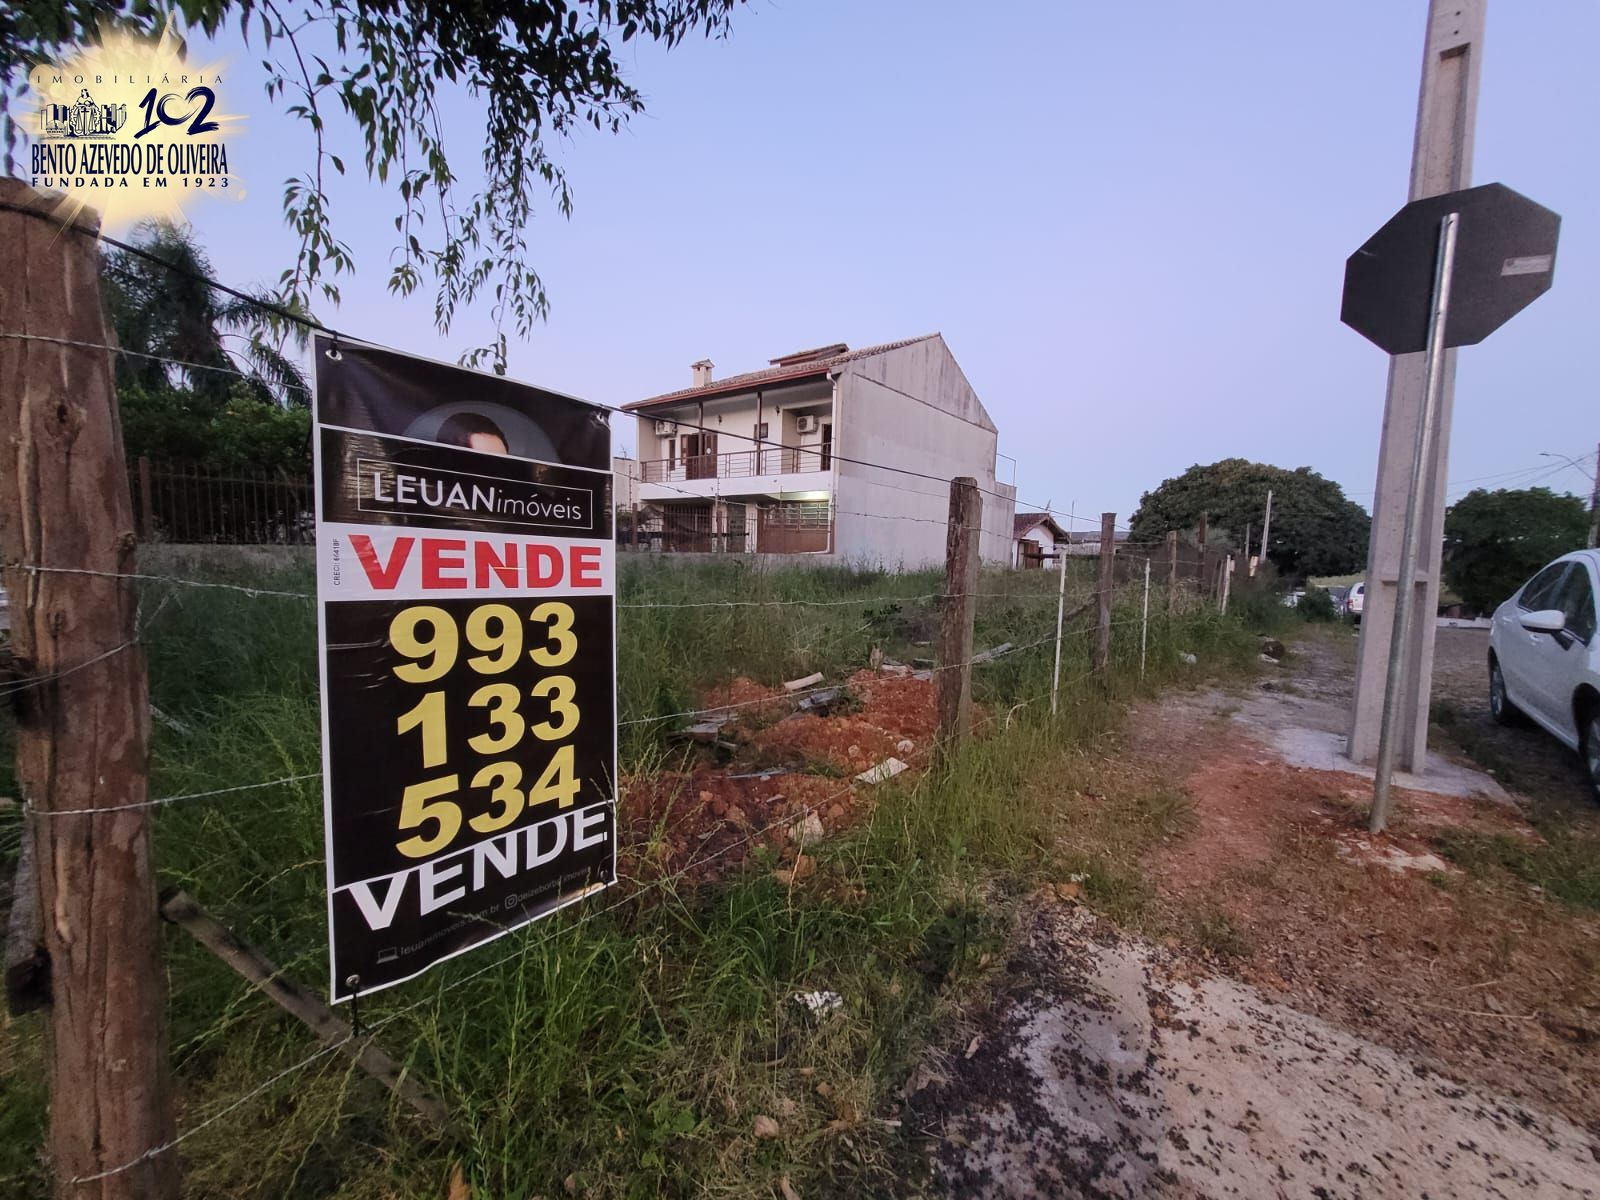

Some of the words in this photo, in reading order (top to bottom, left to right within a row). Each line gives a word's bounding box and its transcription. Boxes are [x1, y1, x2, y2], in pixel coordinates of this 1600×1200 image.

[347, 534, 603, 590] VENDE
[388, 601, 578, 684] 993
[396, 675, 581, 770] 133
[395, 744, 581, 859] 534
[348, 806, 607, 931] VENDE
